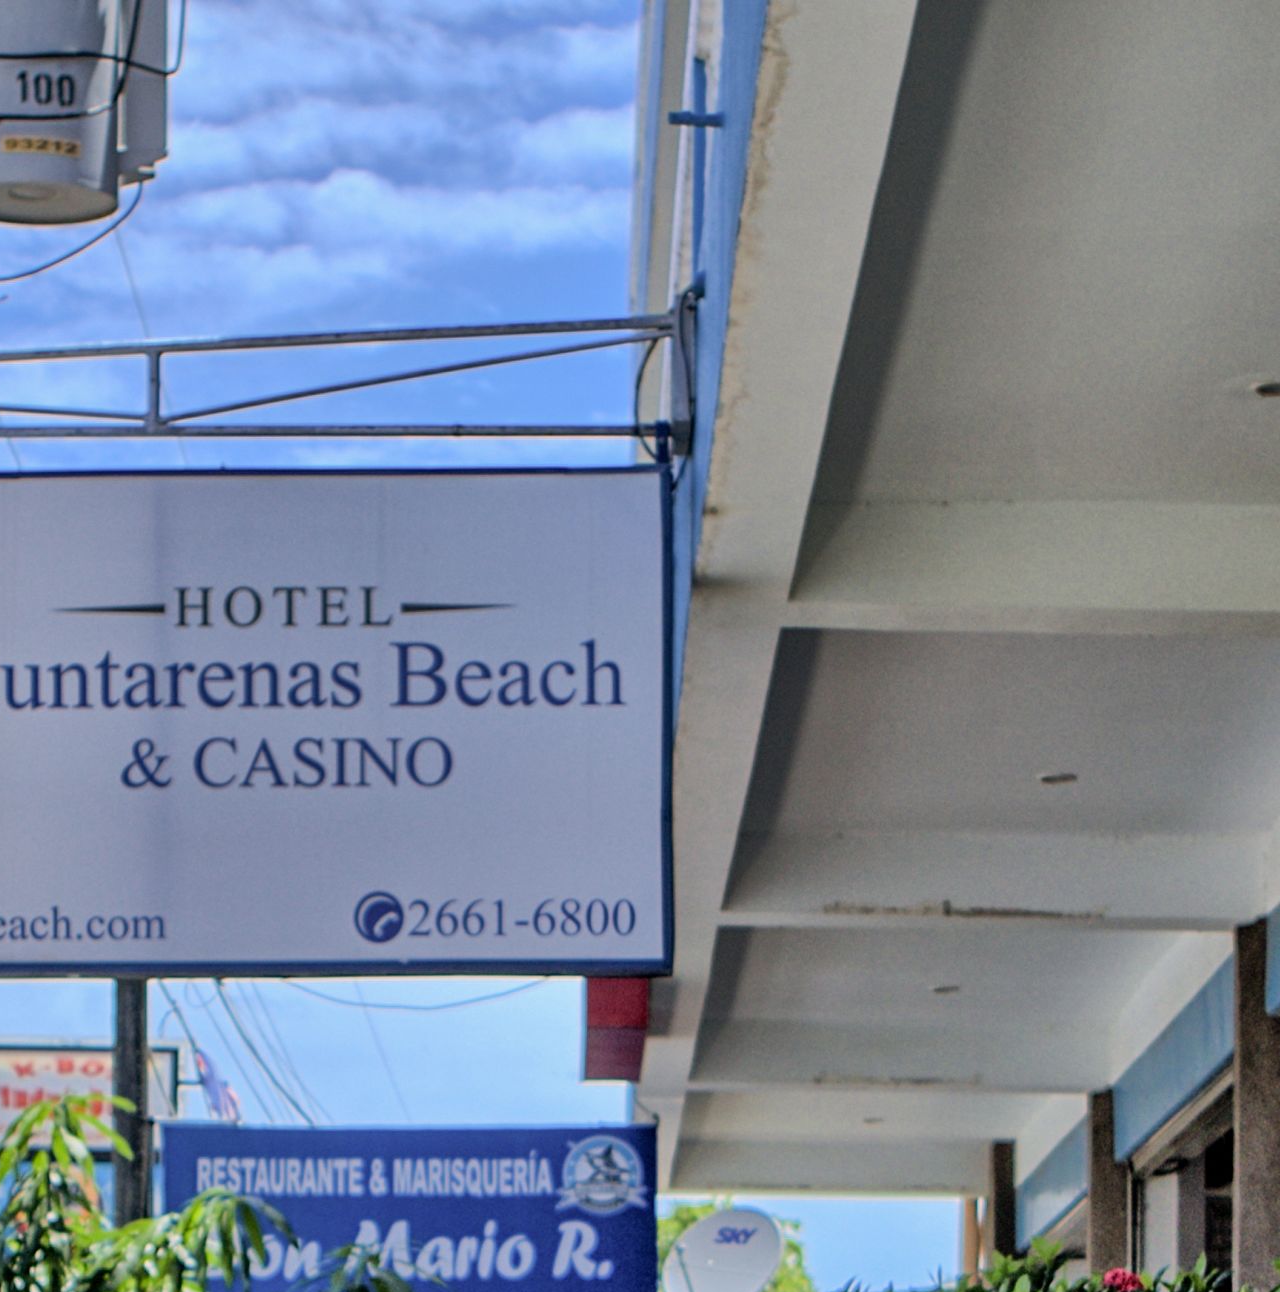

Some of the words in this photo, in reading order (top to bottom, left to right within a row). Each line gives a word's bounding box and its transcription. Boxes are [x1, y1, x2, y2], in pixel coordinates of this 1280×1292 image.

[16, 69, 76, 108] 100
[174, 585, 394, 628] HOTEL
[389, 639, 627, 706] Beach
[120, 736, 173, 789] &
[192, 735, 454, 788] CASINO
[407, 898, 638, 940] 2661-6800
[195, 1157, 363, 1195] RESTAURANTE
[369, 1157, 389, 1195] &
[392, 1149, 553, 1198] MARISQUERÍA
[344, 1218, 538, 1281] Mario
[552, 1219, 615, 1281] R.
